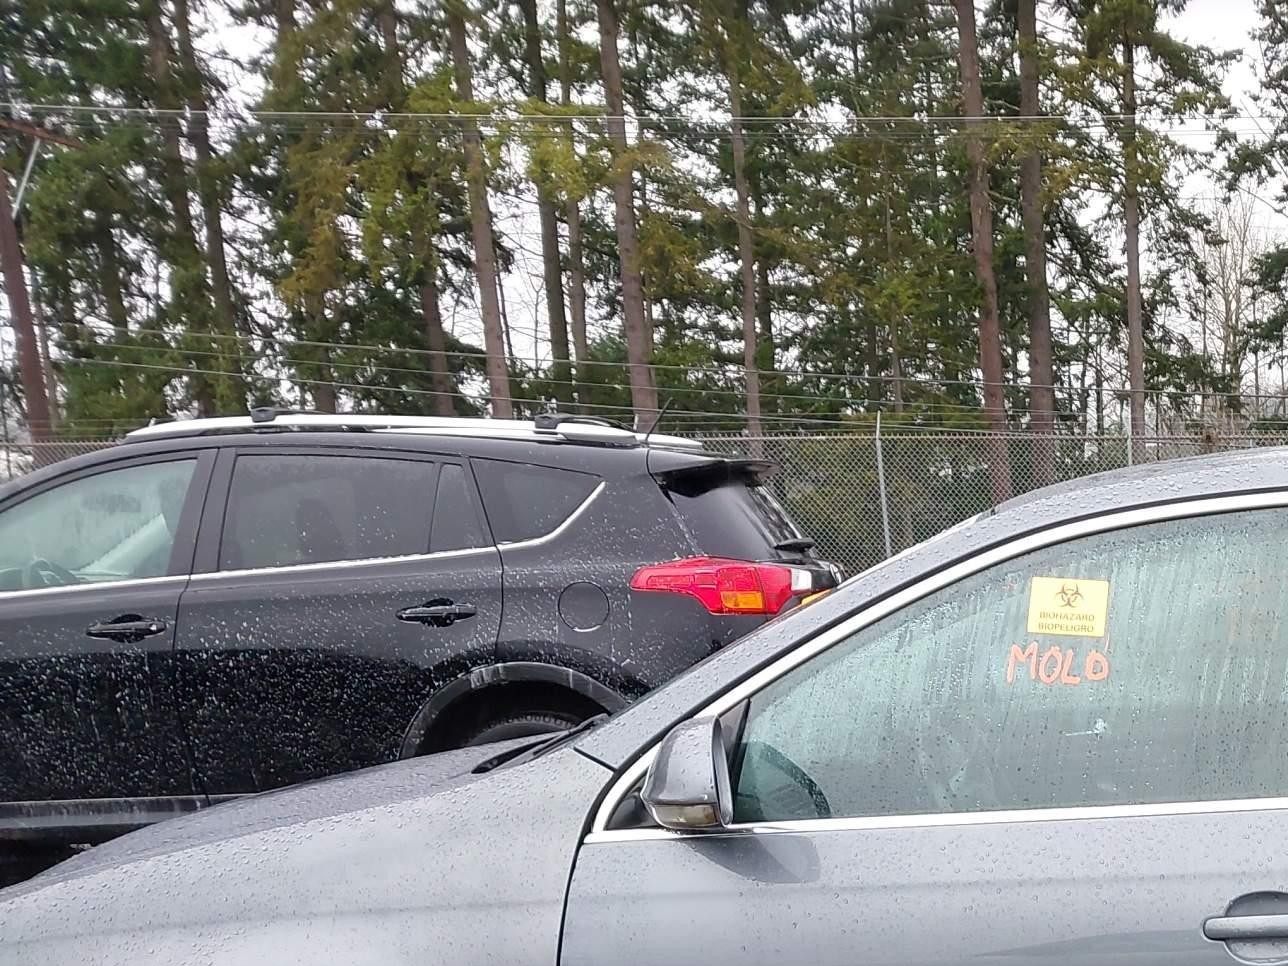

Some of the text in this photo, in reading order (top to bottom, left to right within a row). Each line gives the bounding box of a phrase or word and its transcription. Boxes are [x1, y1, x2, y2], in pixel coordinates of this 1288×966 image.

[1039, 611, 1095, 621] BIOHAZARD
[1038, 622, 1094, 633] BIOPELIGRO
[1006, 641, 1110, 686] MOLD
